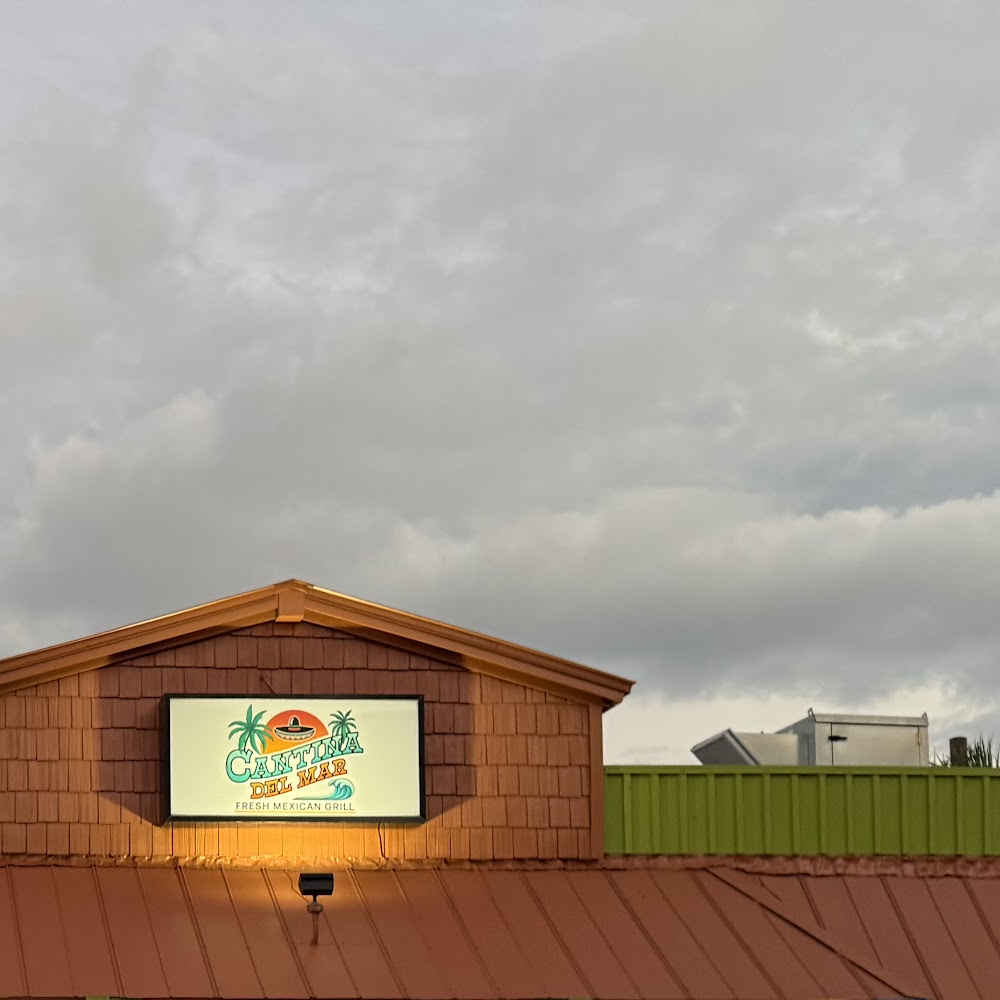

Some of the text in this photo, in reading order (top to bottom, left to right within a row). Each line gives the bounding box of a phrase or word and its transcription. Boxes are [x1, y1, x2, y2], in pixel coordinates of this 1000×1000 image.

[225, 732, 364, 783] CANTINA
[250, 758, 348, 799] DEL MAR
[235, 801, 355, 812] FRESH MEXICAN GRILL
